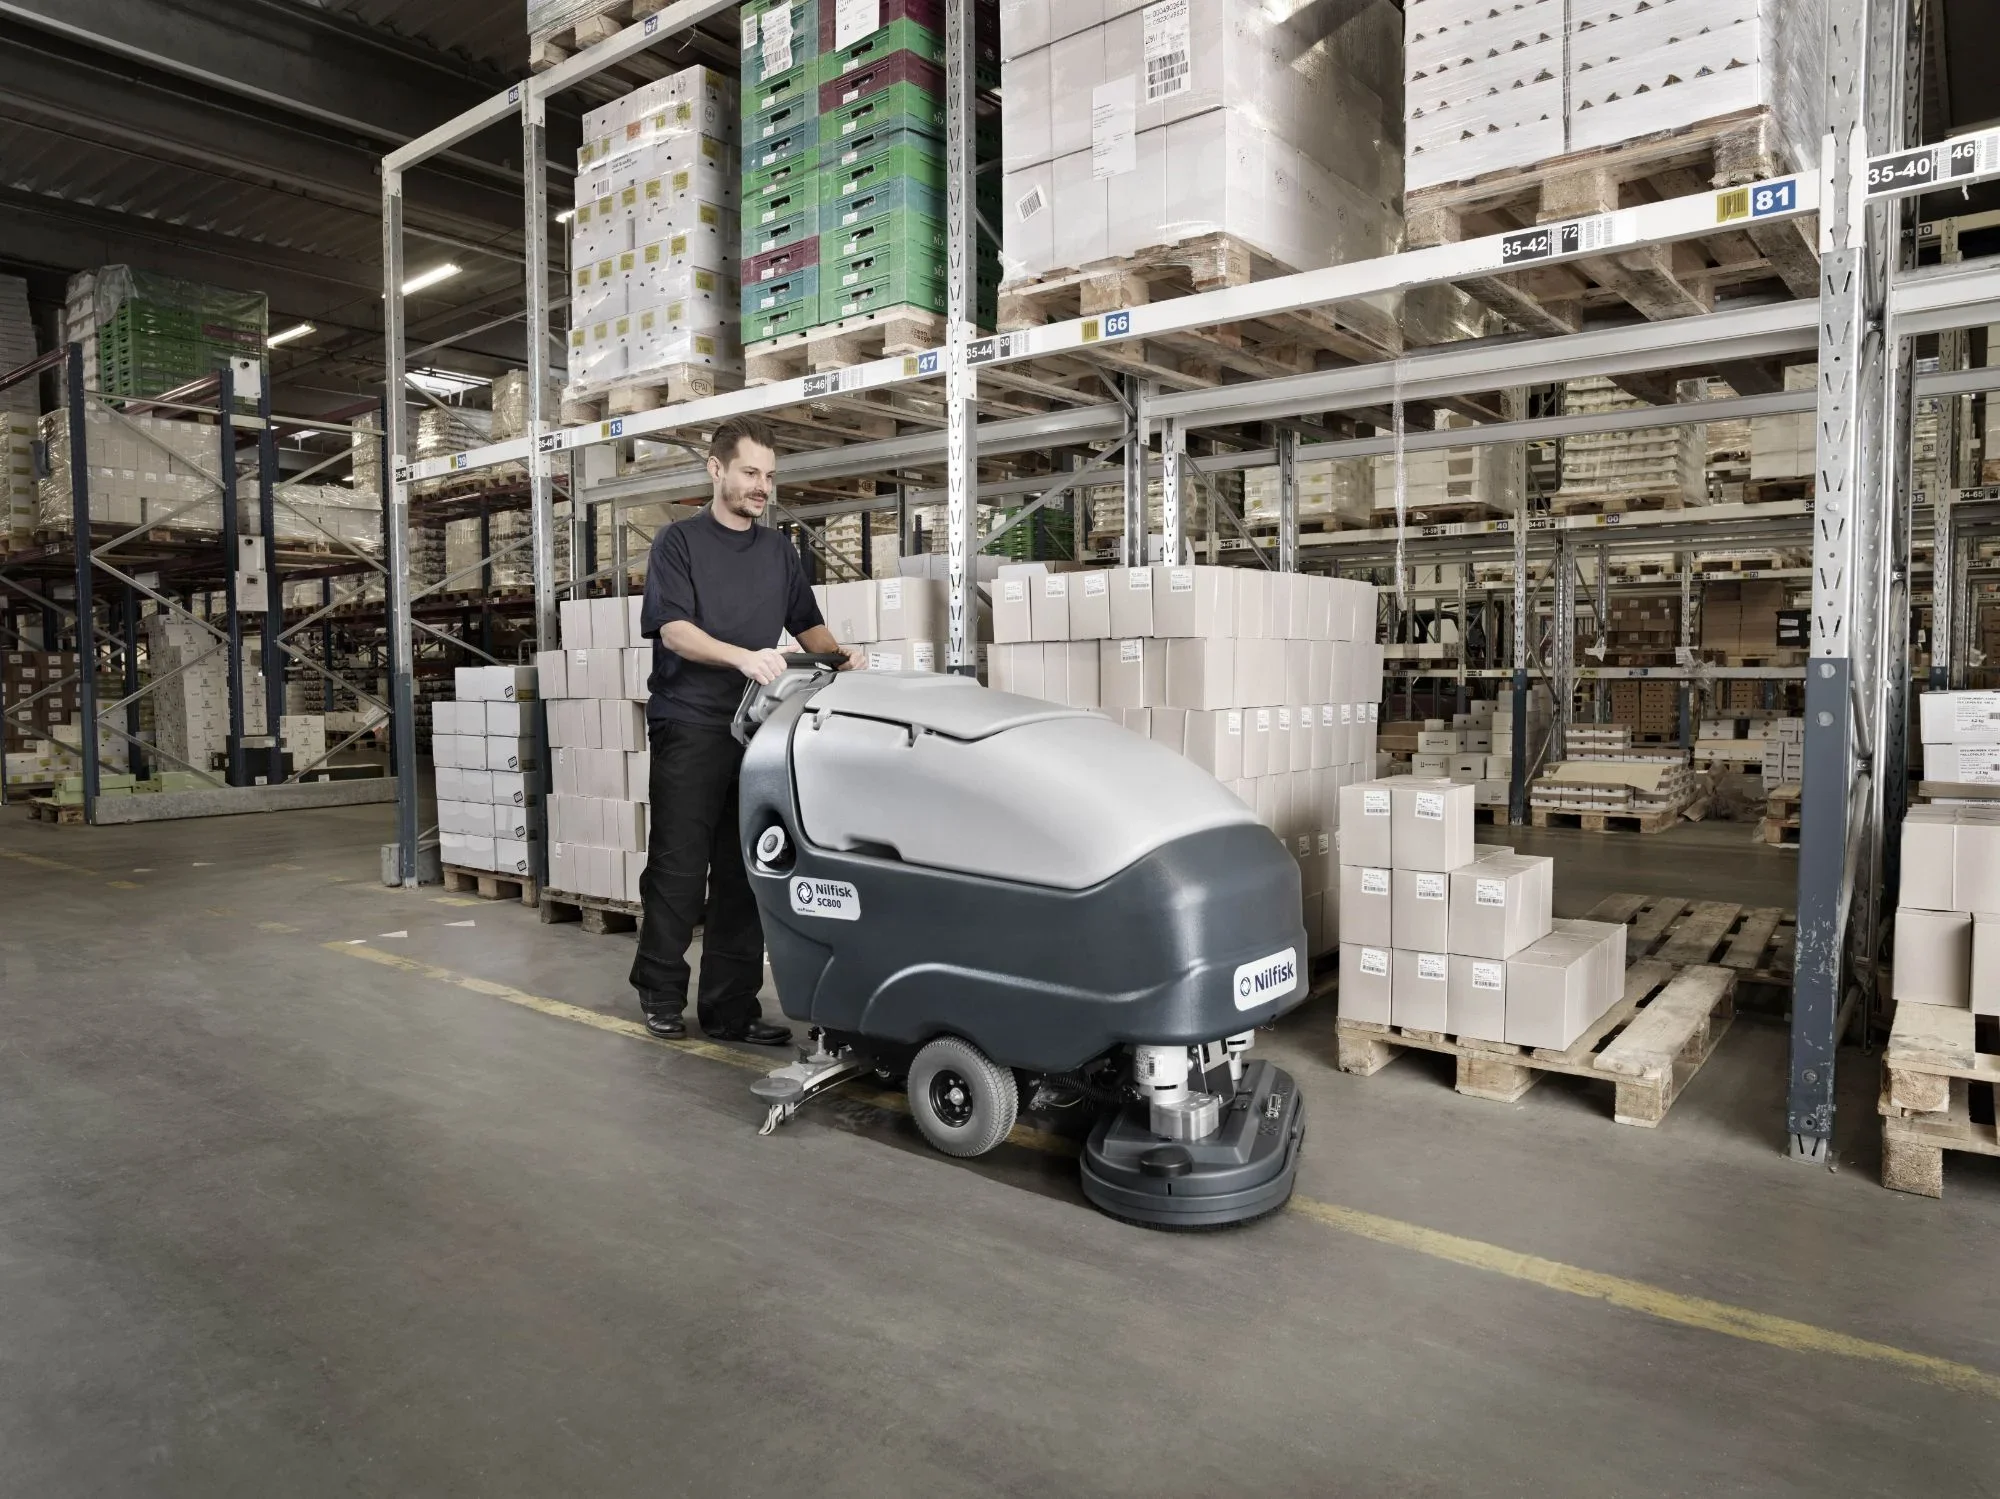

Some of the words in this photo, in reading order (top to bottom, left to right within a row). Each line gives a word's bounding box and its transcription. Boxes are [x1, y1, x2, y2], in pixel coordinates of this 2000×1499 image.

[1868, 158, 1930, 186] 35-40
[1951, 143, 1975, 159] 46
[1756, 186, 1790, 211] 81
[1503, 236, 1547, 257] 35-42
[1562, 226, 1578, 240] 72
[1107, 316, 1128, 333] 66
[966, 343, 993, 359] 35-44
[1000, 337, 1010, 347] 30
[919, 355, 936, 370] 47
[803, 379, 825, 392] 35-46
[831, 374, 839, 383] 91
[611, 422, 622, 435] 13
[458, 455, 467, 466] 39
[816, 884, 852, 898] Nilfisk
[817, 898, 842, 908] SC800
[1254, 961, 1294, 993] Nilfisk
